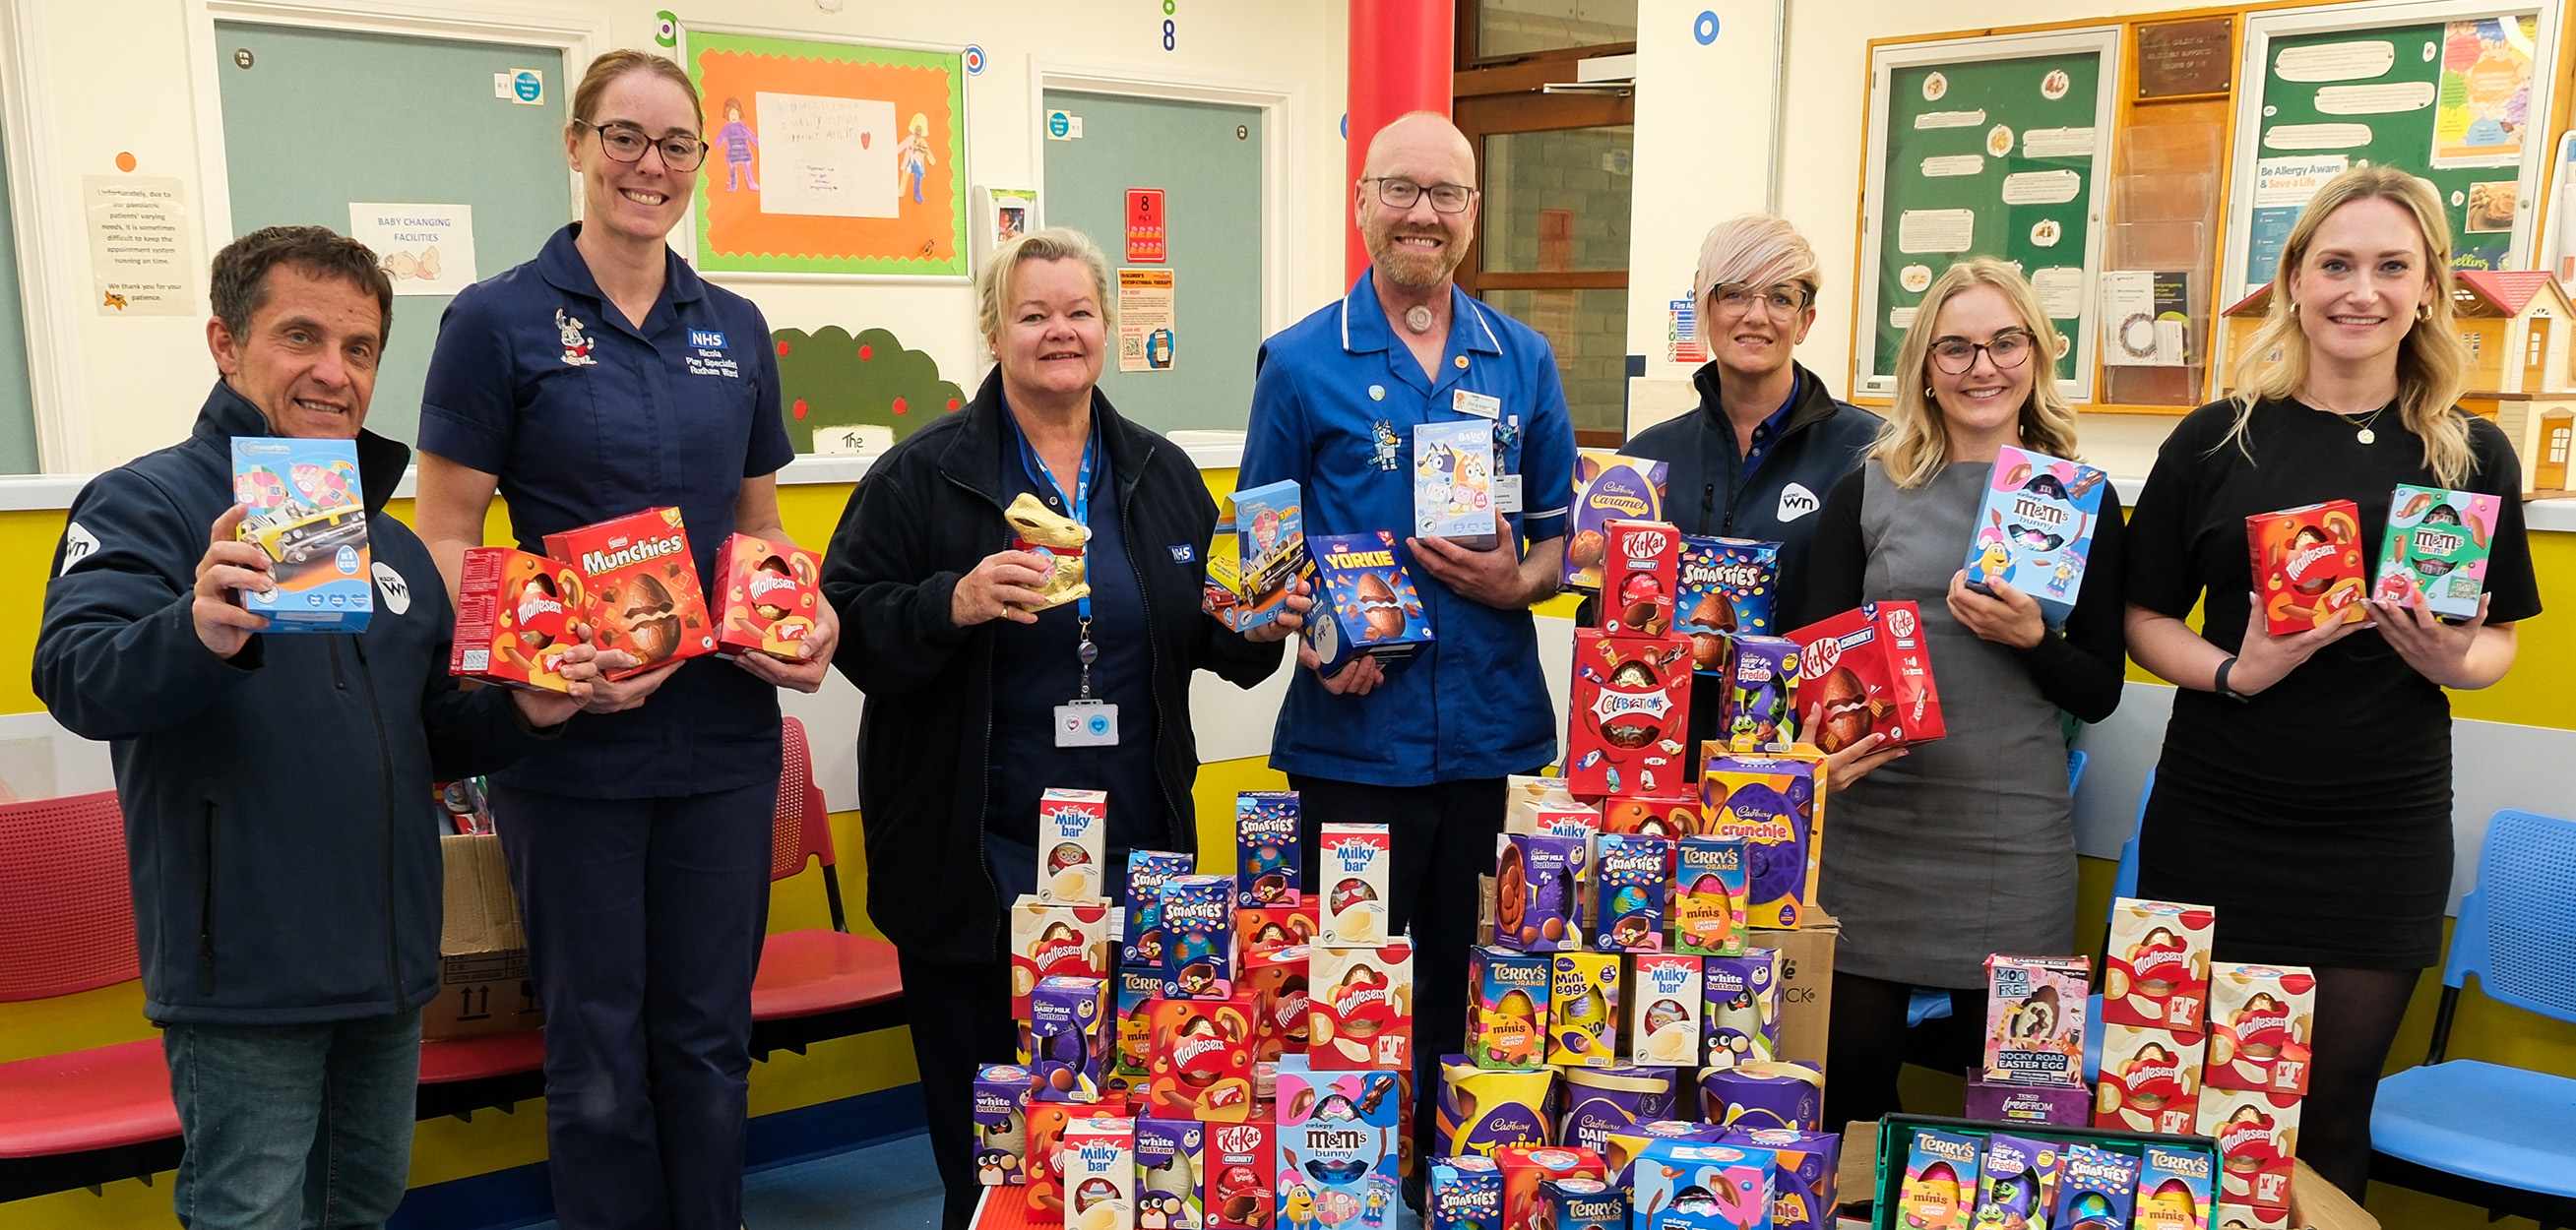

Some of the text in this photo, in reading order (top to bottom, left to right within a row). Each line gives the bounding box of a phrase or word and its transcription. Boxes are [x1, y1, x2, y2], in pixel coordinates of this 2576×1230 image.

[1163, 19, 1175, 51] 8
[2261, 164, 2341, 177] Be Allergy Aware
[2260, 179, 2268, 189] &
[2269, 179, 2292, 189] Save
[2299, 178, 2316, 188] Life
[1141, 196, 1149, 212] 8
[378, 217, 451, 227] BABY CHANGING
[394, 233, 438, 242] FACILITIES
[692, 332, 723, 346] NHS
[685, 357, 702, 367] Play
[842, 432, 864, 449] The
[1458, 430, 1488, 443] BLUEY
[1603, 480, 1635, 496] Cadbury
[1593, 494, 1647, 511] Caramel
[2019, 517, 2054, 531] bunny
[1627, 531, 1665, 558] KitKat
[2419, 545, 2450, 556] minis
[582, 534, 684, 576] Munchies
[1171, 546, 1191, 561] NHS
[1324, 550, 1395, 570] YORKIE
[2286, 543, 2337, 582] Maltesers
[1682, 564, 1758, 587] SMARTIES
[749, 576, 796, 600] Maltesers
[517, 596, 562, 626] Maltesers
[1892, 610, 1913, 636] KitKat
[1841, 628, 1873, 646] CHUNKY
[1800, 639, 1840, 678] KitKat
[1738, 669, 1769, 681] Freddo
[1736, 805, 1772, 819] Cadbury
[1055, 813, 1091, 829] Milky
[1240, 818, 1293, 834] SMARTIES
[1061, 826, 1083, 837] bar
[1551, 824, 1587, 837] Milky
[1721, 824, 1787, 838] crunchie
[1337, 846, 1375, 862] Milky
[1344, 859, 1367, 872] bar
[1534, 860, 1561, 869] buttons
[1604, 856, 1662, 872] SMARTIES
[1165, 902, 1223, 919] SMARTIES
[1686, 906, 1720, 918] minis
[1036, 945, 1083, 972] Maltesers
[2133, 951, 2182, 976] Maltesers
[1555, 971, 1584, 984] Mini
[1652, 969, 1688, 984] Milky
[1708, 974, 1742, 983] white
[1996, 969, 2028, 982] MOO
[1555, 983, 1588, 996] eggs
[1659, 981, 1681, 994] bar
[1998, 984, 2029, 996] FREE
[1335, 988, 1385, 1018] Maltesers
[1493, 1021, 1526, 1033] minis
[2235, 1015, 2285, 1040] Maltesers
[1173, 1039, 1225, 1069] Maltesers
[1998, 1060, 2040, 1069] EASTER
[2126, 1066, 2174, 1090] Maltesers
[976, 1097, 1011, 1106] white
[2002, 1096, 2053, 1112] freeFROM
[1490, 1118, 1531, 1133] Cadbury
[1581, 1115, 1620, 1130] Cadbury
[1139, 1138, 1174, 1147] white
[1223, 1127, 1260, 1152] KitKat
[2221, 1129, 2271, 1153] Maltesers
[1080, 1148, 1118, 1162] Milky
[1315, 1148, 1353, 1159] bunny
[1940, 1153, 1973, 1163] ORANGE
[1088, 1159, 1110, 1173] bar
[1990, 1158, 2023, 1173] Freddo
[2069, 1161, 2130, 1183] SMARTIES
[2174, 1169, 2208, 1179] ORANGE
[1440, 1192, 1497, 1209] SMARTIES
[1914, 1192, 1948, 1204] minis
[2149, 1208, 2185, 1221] minis
[1663, 1218, 1692, 1227] crispy
